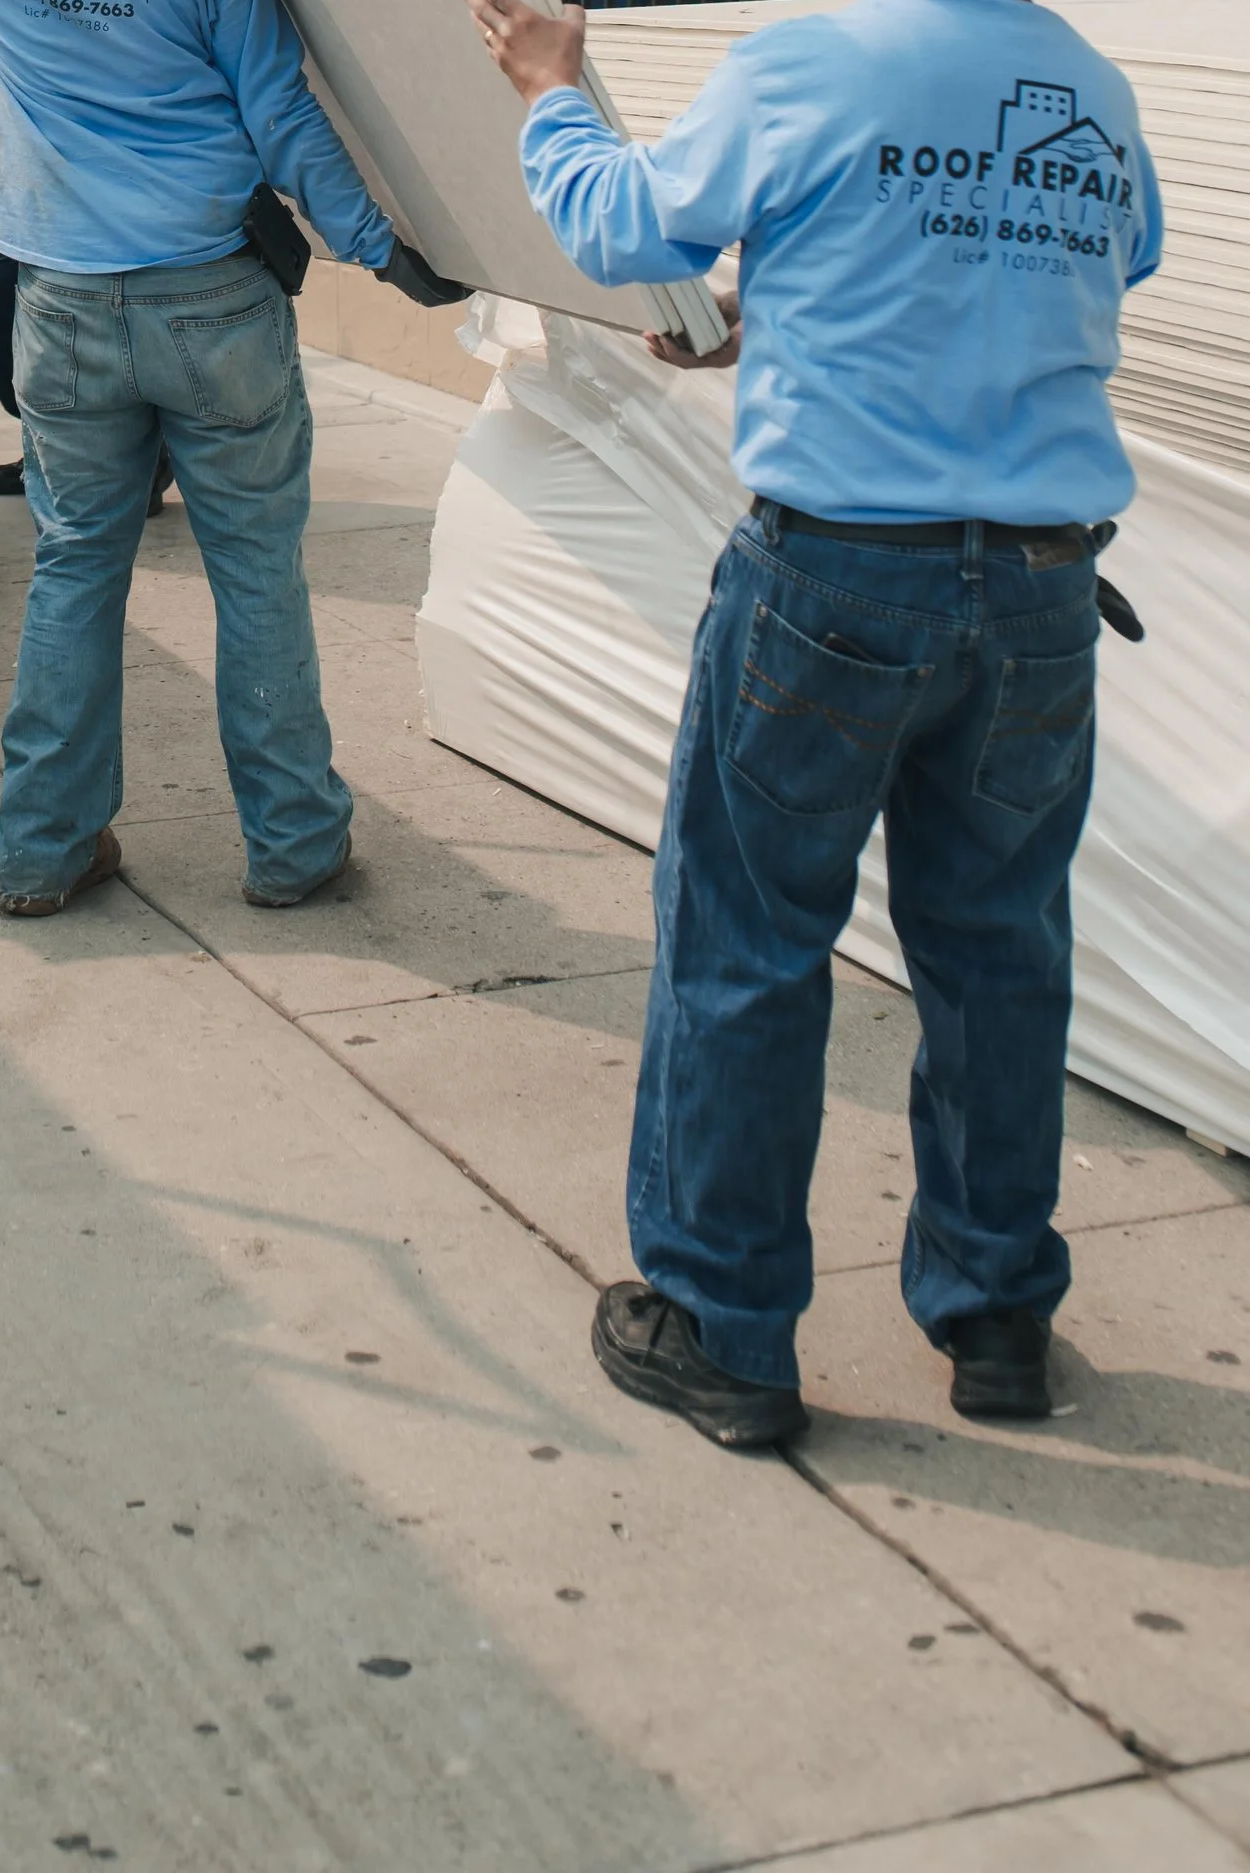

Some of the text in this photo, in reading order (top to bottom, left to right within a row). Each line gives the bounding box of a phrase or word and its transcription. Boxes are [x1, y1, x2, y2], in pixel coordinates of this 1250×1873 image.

[879, 145, 1133, 210] ROOF REPAIR
[920, 210, 989, 242] (626)
[953, 247, 1077, 277] Lic# 100738
